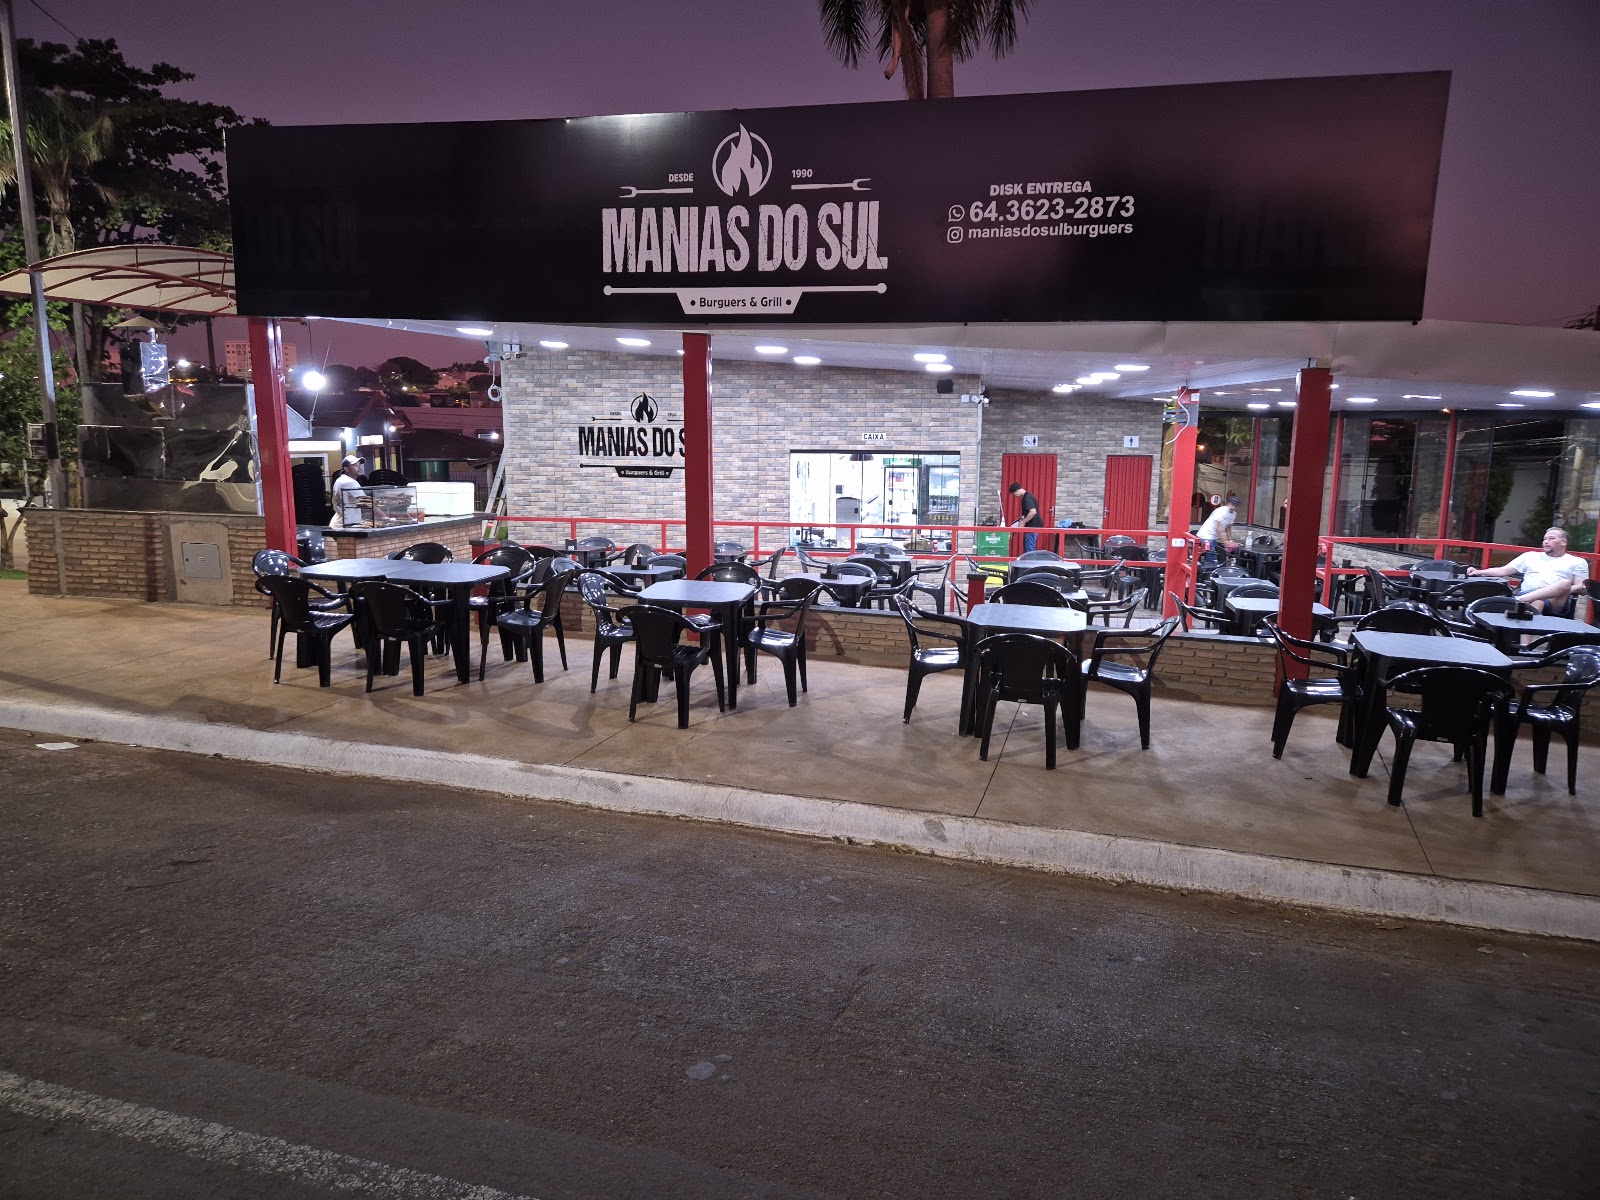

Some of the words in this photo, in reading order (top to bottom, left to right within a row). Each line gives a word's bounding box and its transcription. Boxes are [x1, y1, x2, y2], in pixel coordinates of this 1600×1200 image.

[668, 172, 694, 183] DESDE
[791, 168, 813, 179] 1990
[989, 183, 1024, 196] DISK
[1026, 180, 1092, 195] ENTREGA
[969, 195, 1135, 222] 64.3623-2873
[602, 204, 750, 273] MANIAS
[758, 203, 809, 272] DO
[815, 200, 888, 271] SUL
[968, 222, 1133, 239] maniasdosulburguers
[699, 296, 747, 309] Burguers
[749, 296, 758, 307] &
[760, 296, 782, 307] Grill
[578, 426, 649, 456] MANIAS
[652, 427, 675, 457] DO
